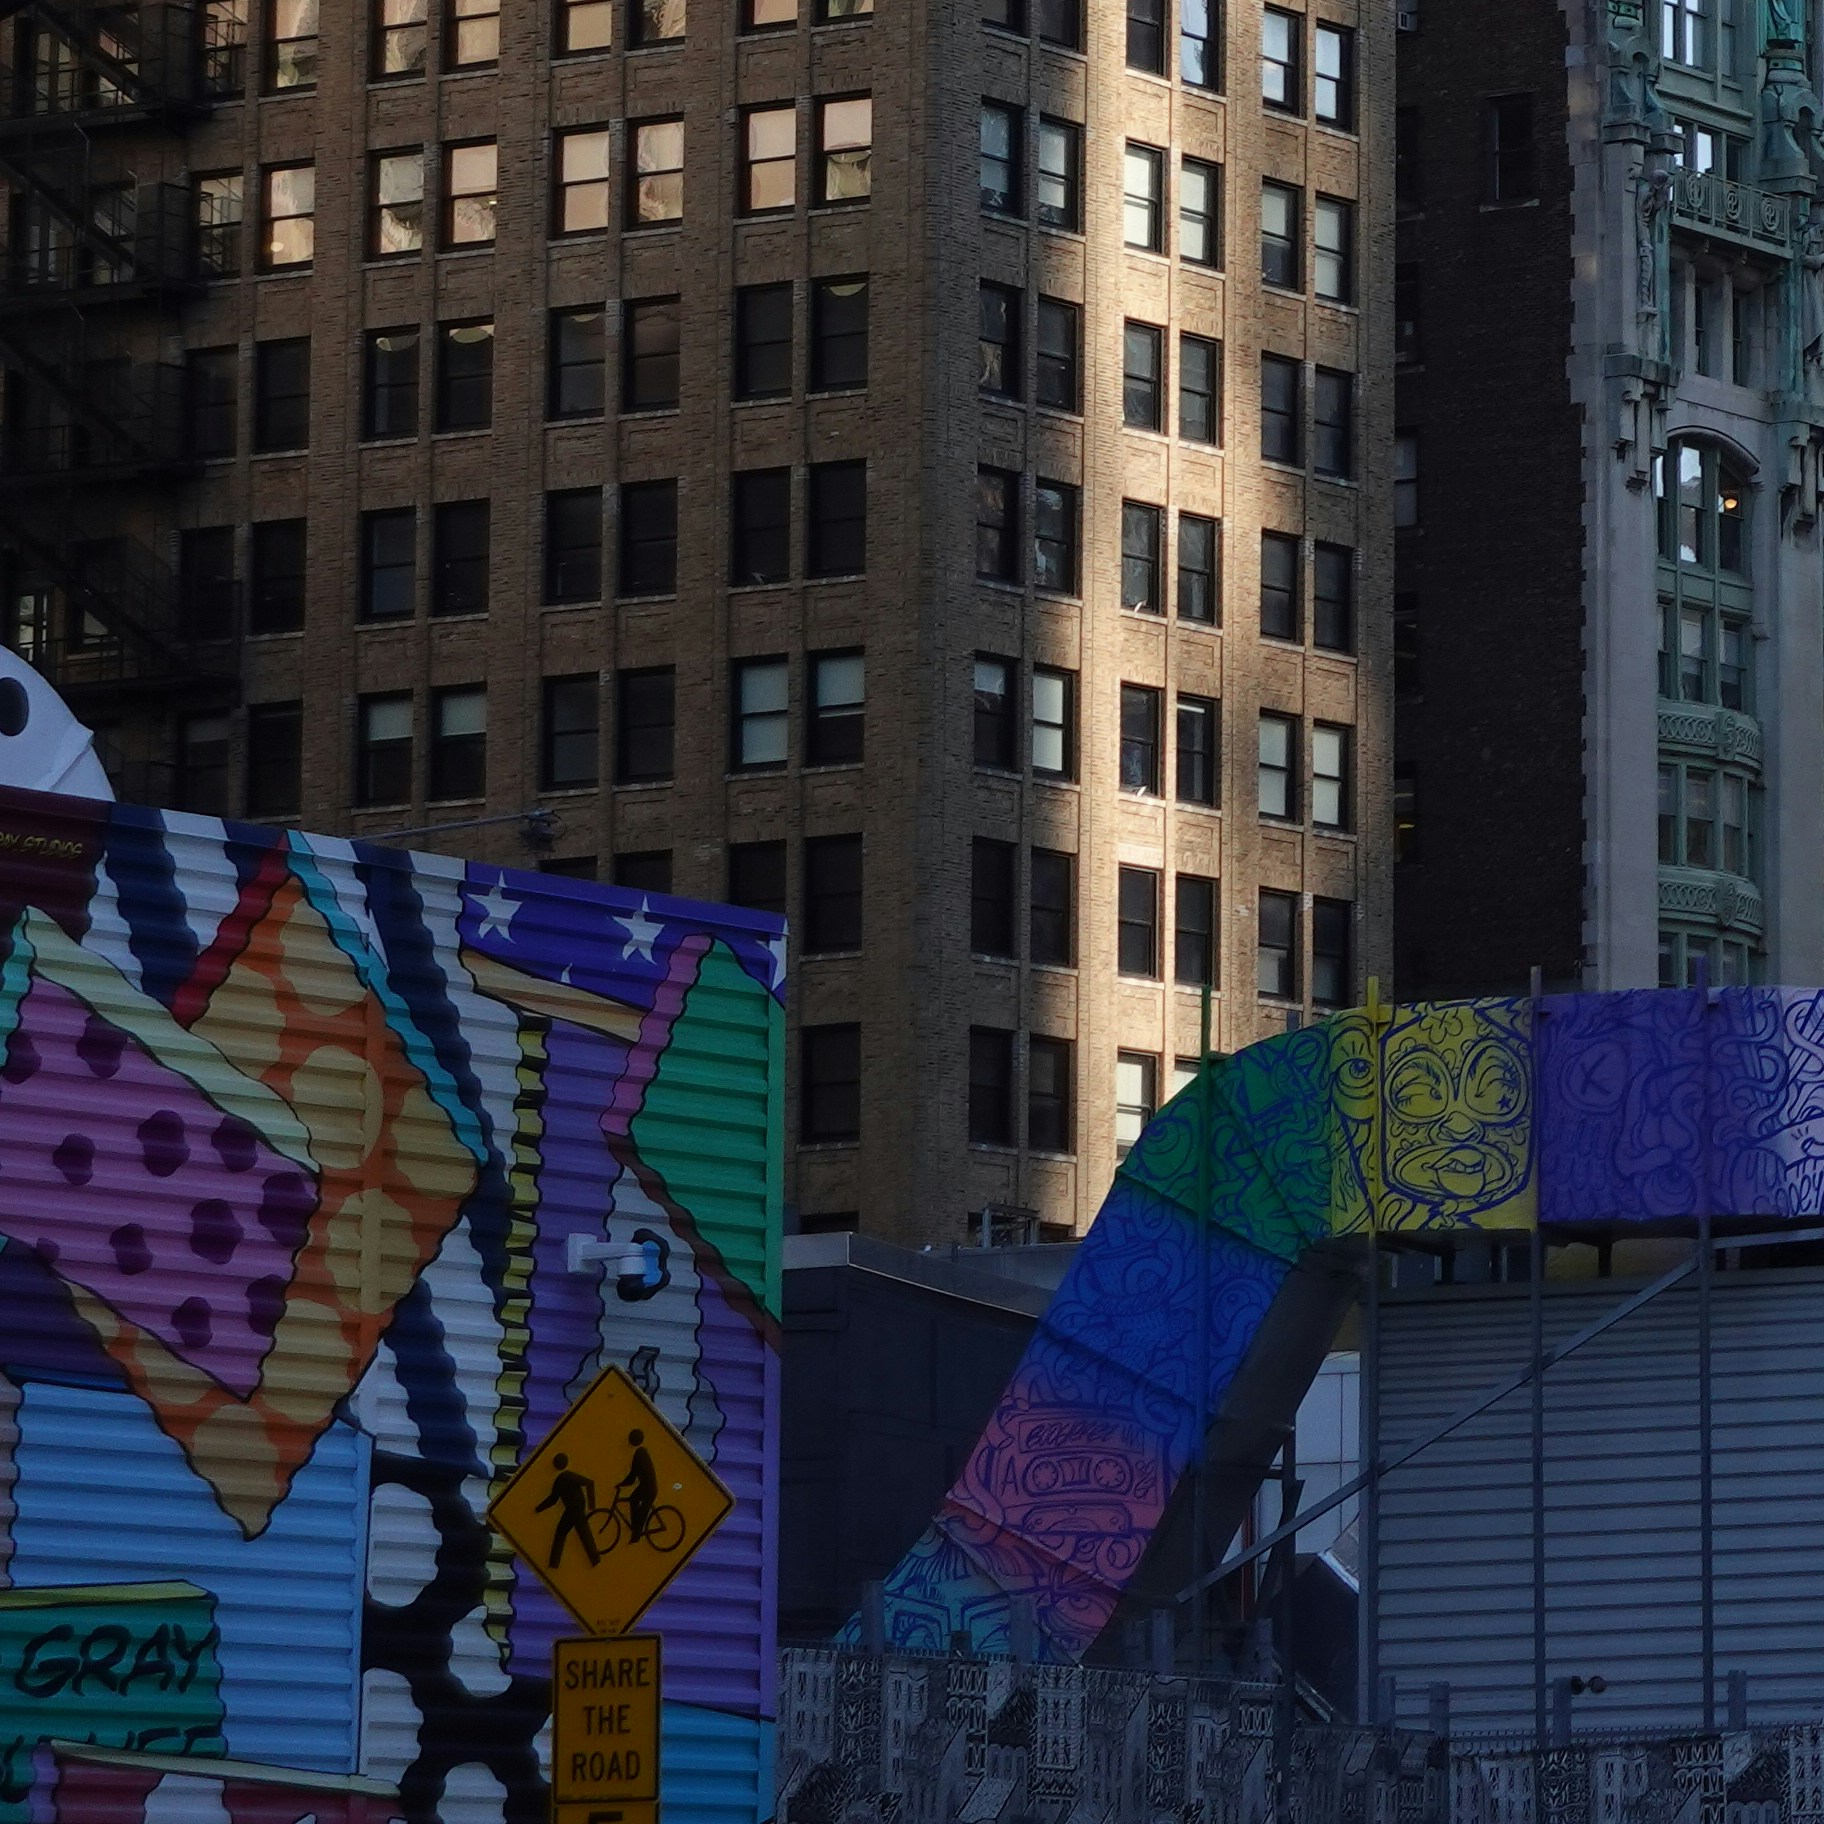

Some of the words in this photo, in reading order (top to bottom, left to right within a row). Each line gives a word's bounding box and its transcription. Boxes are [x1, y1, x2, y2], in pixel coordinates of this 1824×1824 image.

[14, 1622, 222, 1699] GRAY
[564, 1657, 651, 1690] SHARE
[582, 1703, 632, 1736] THE
[571, 1749, 641, 1783] ROAD
